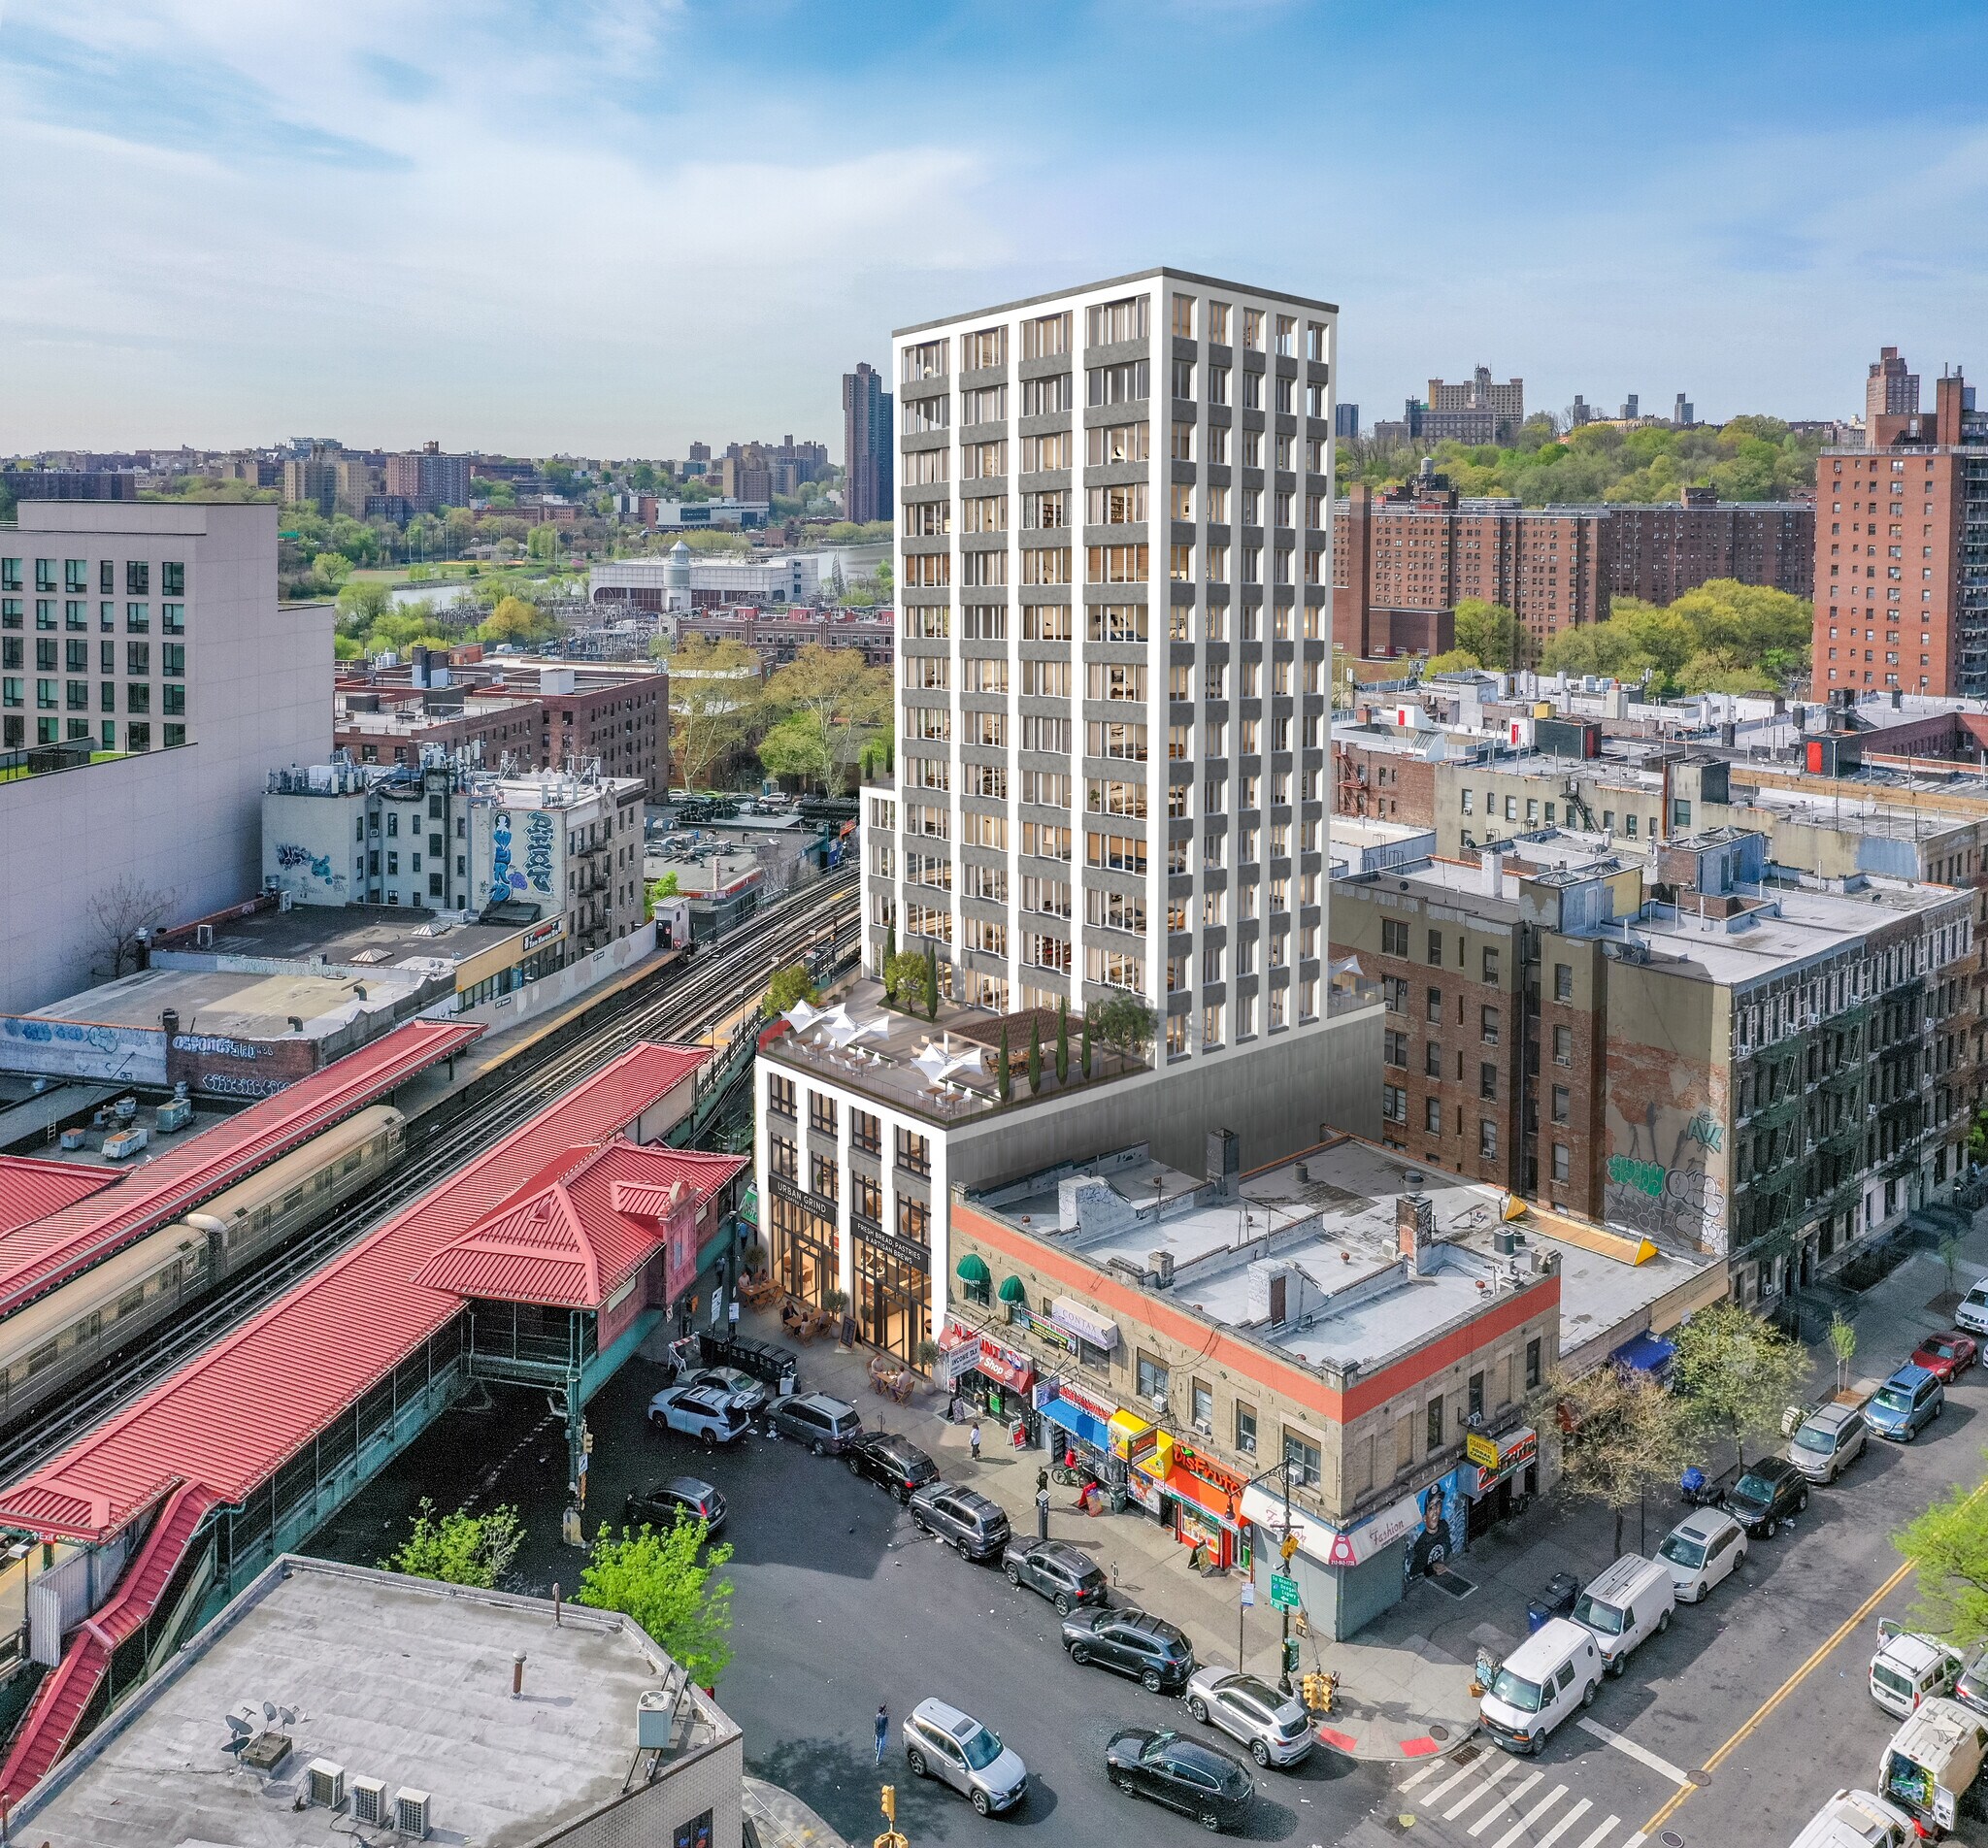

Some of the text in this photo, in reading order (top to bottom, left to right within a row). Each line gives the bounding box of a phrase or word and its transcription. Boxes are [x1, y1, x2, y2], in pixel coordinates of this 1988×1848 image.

[778, 1182, 826, 1213] URBAN GRIND
[784, 1196, 800, 1205] COFFEE
[804, 1205, 818, 1215] BAKERY
[857, 1223, 920, 1260] FRESH BREAD, PASTRIES
[870, 1238, 893, 1254] ARTISAN
[893, 1250, 912, 1264] BREWS
[1062, 1309, 1096, 1334] CONTAX
[951, 1352, 969, 1365] INCOME
[970, 1347, 978, 1357] TAX
[984, 1358, 1004, 1374] Shop
[1472, 1447, 1491, 1459] SODAS
[39, 1532, 53, 1540] Exit
[1370, 1520, 1404, 1545] Fashion
